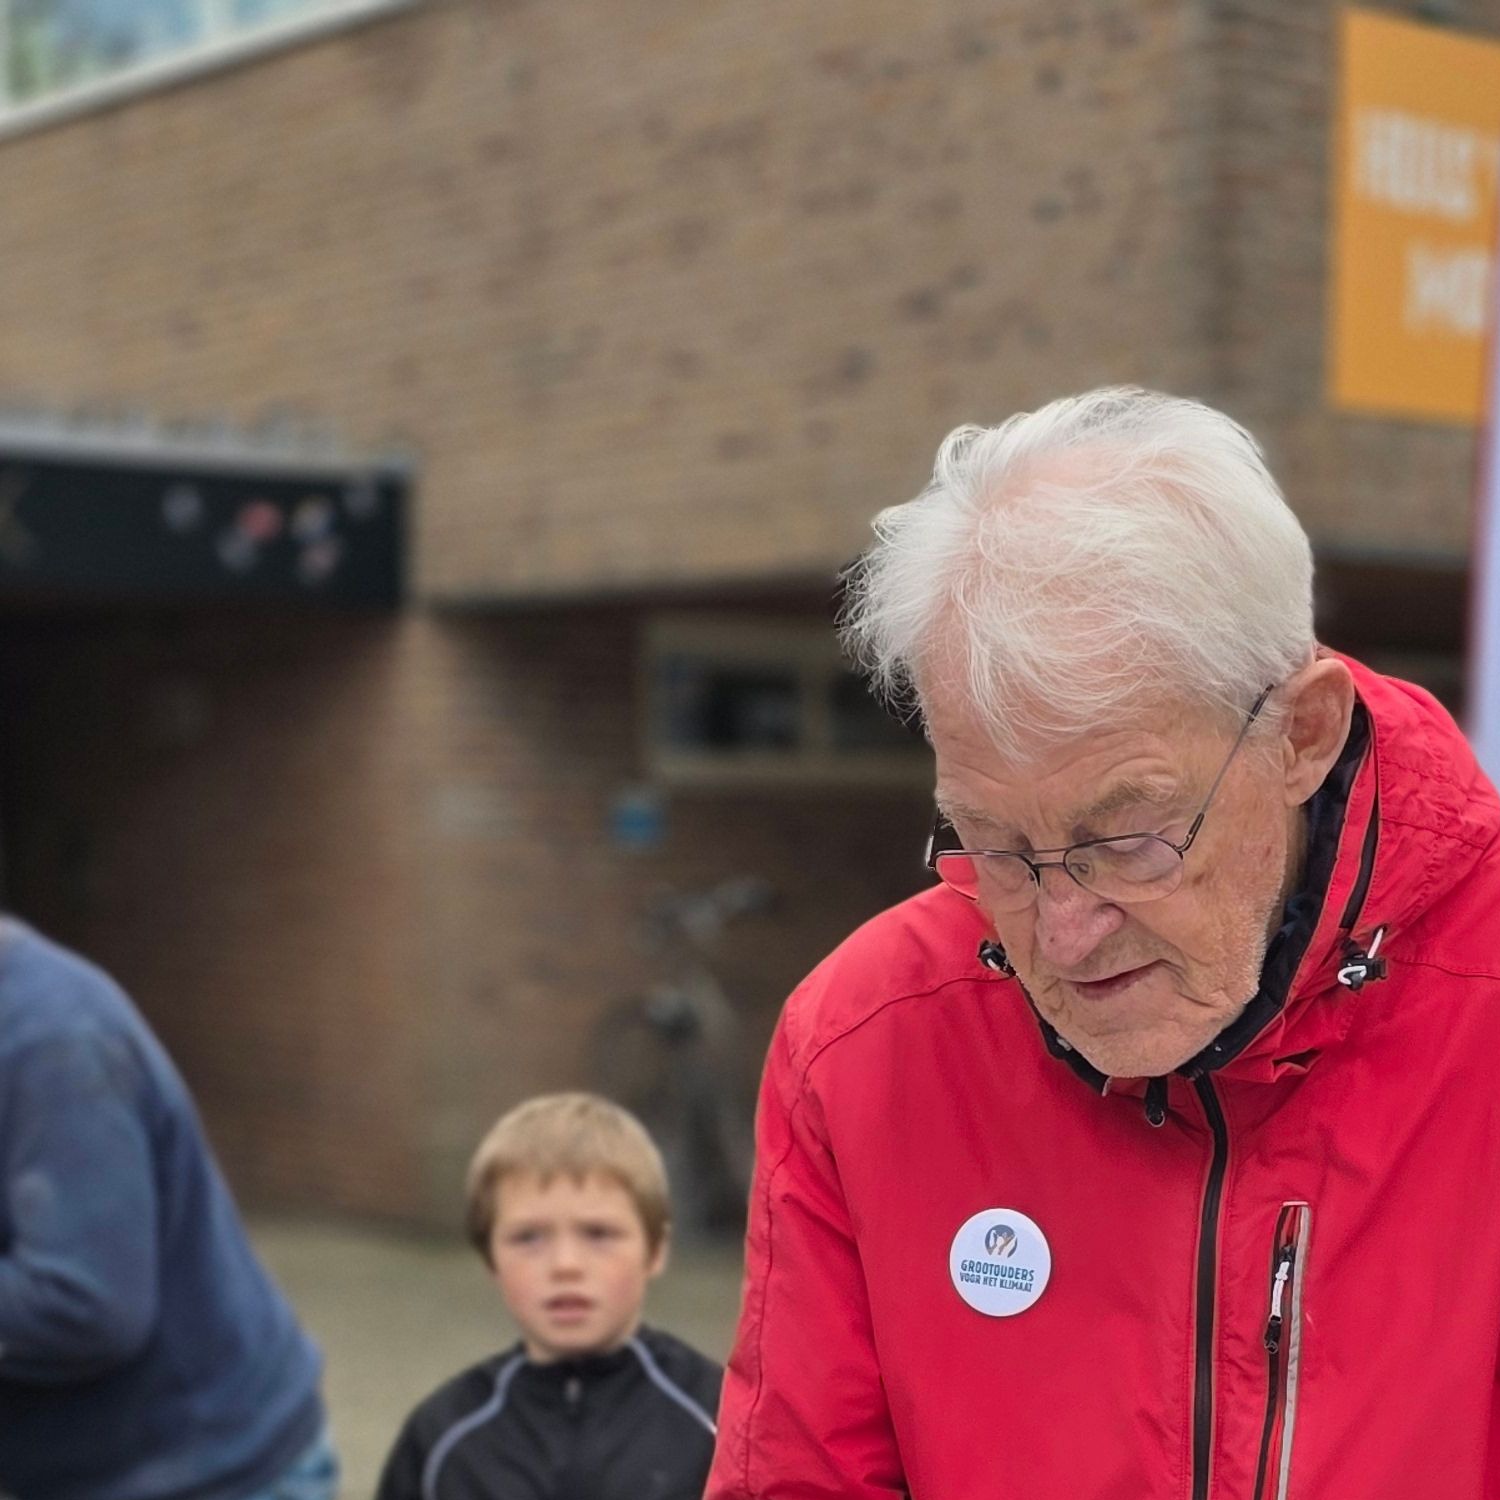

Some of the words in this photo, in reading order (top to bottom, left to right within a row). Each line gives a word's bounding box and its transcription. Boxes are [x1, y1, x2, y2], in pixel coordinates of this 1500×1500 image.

[960, 1259, 1035, 1281] GROOTOUDERS
[960, 1271, 981, 1284] VOOR
[982, 1275, 998, 1287] HET
[1000, 1278, 1033, 1292] KLIMAAT
